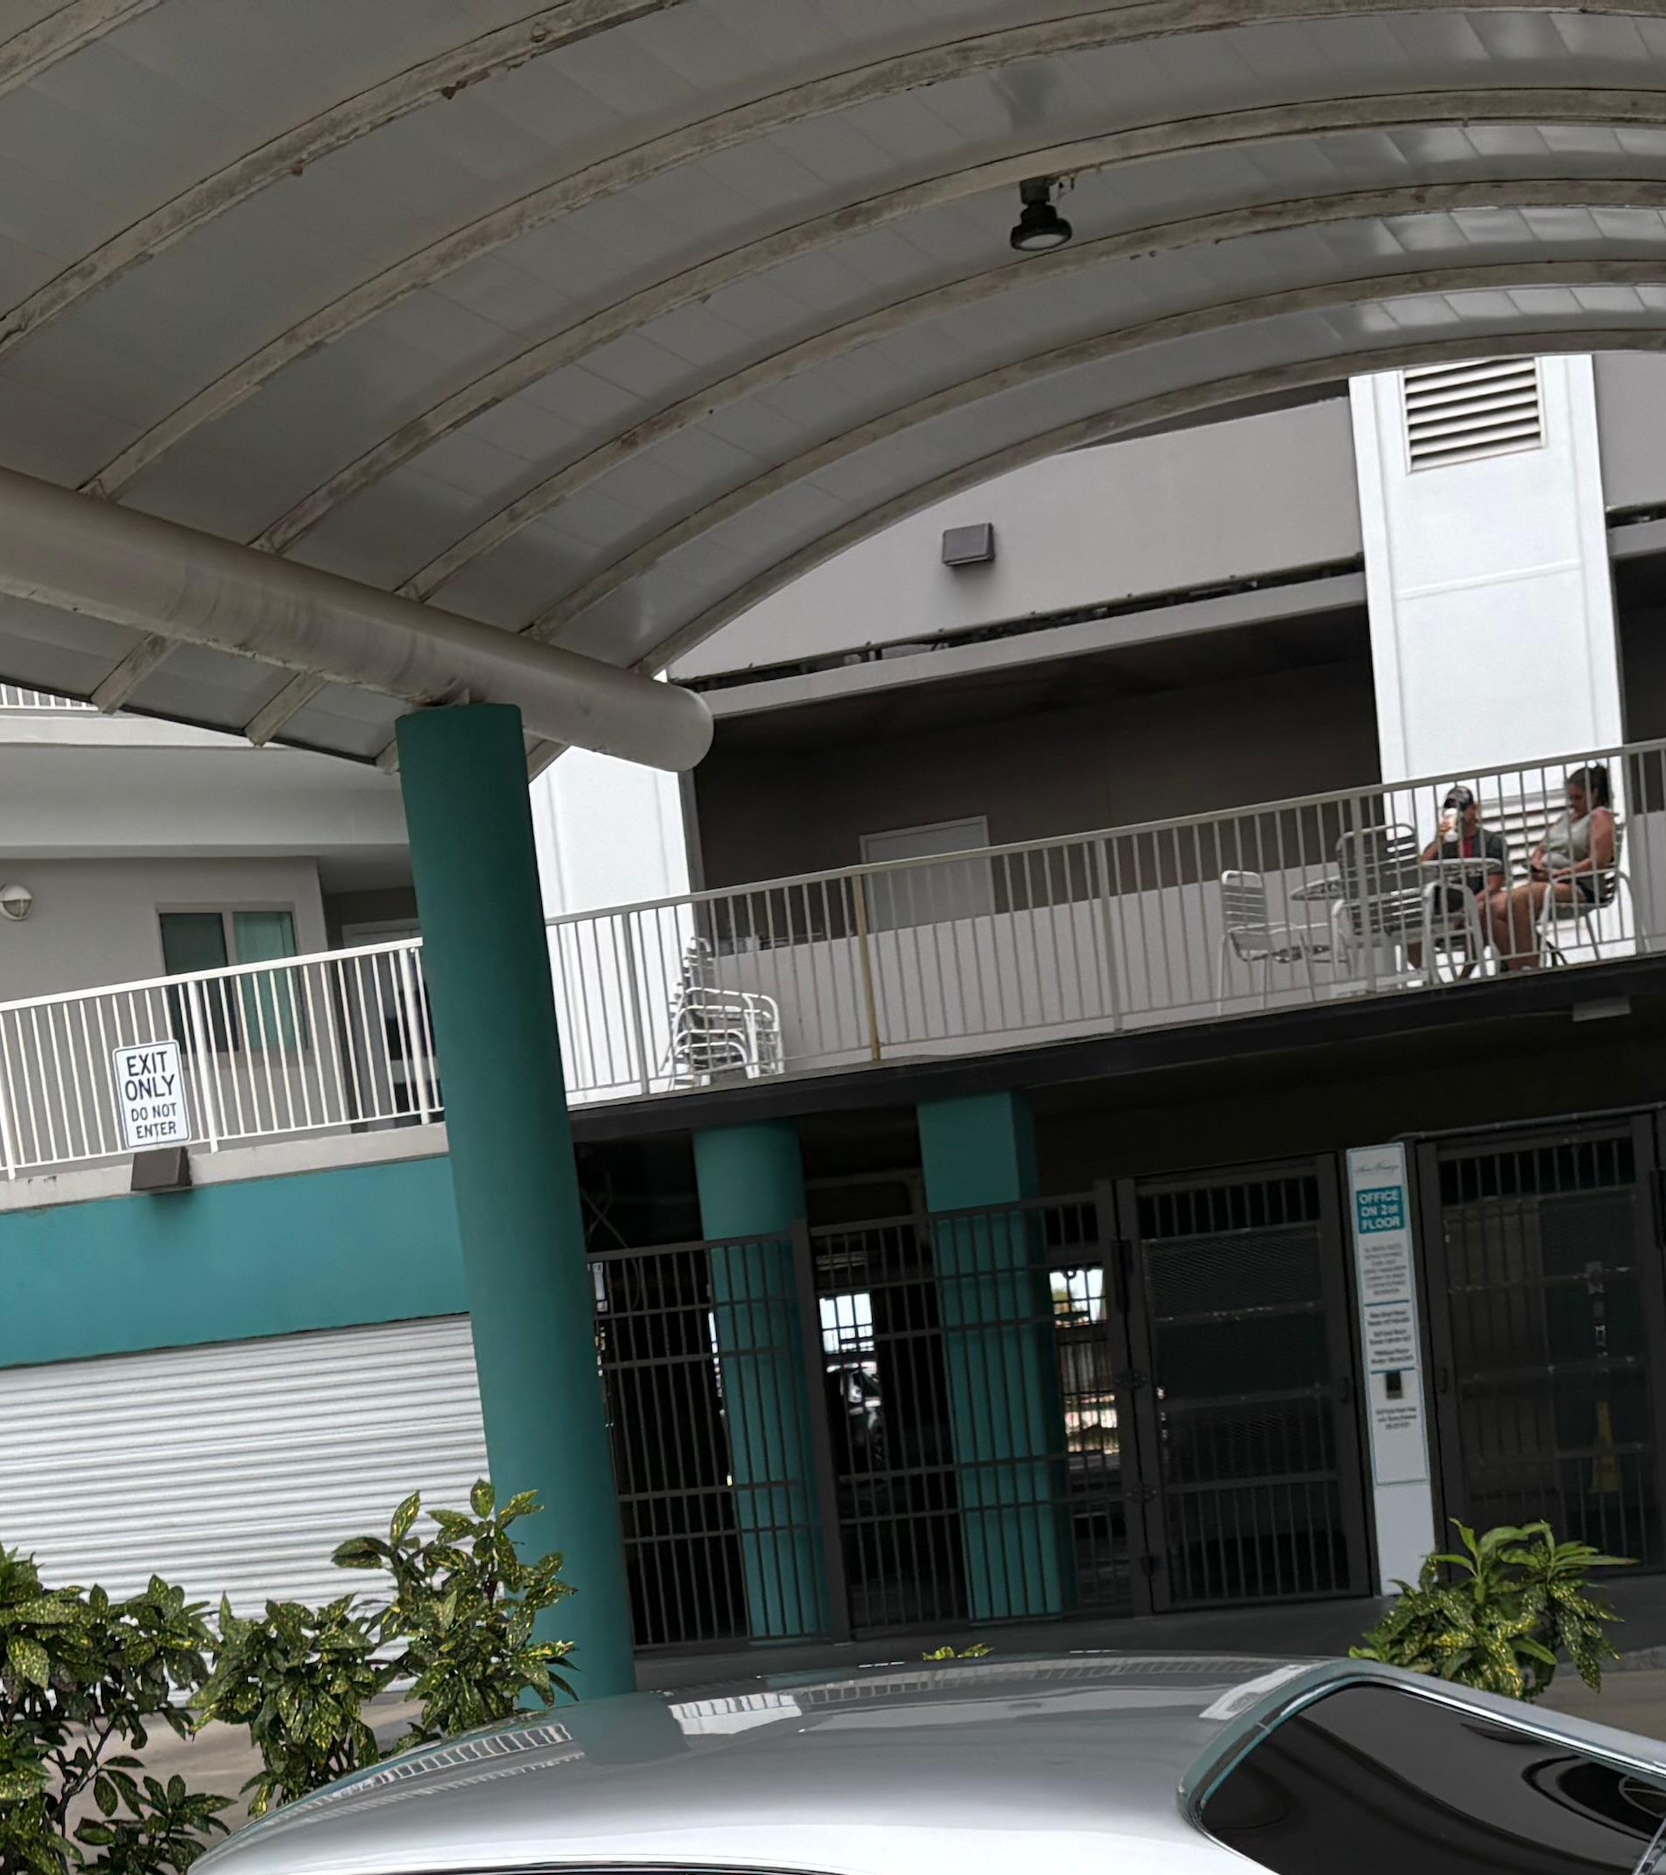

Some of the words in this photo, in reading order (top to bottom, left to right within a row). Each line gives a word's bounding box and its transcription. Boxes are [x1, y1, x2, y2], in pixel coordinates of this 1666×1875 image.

[126, 1050, 168, 1077] EXIT
[124, 1074, 175, 1102] ONLY
[131, 1106, 148, 1122] DO
[152, 1102, 177, 1119] NOT
[136, 1121, 177, 1139] ENTER
[1358, 1188, 1400, 1205] OFFICE
[1361, 1205, 1378, 1217] ON
[1361, 1215, 1401, 1231] FLOOR
